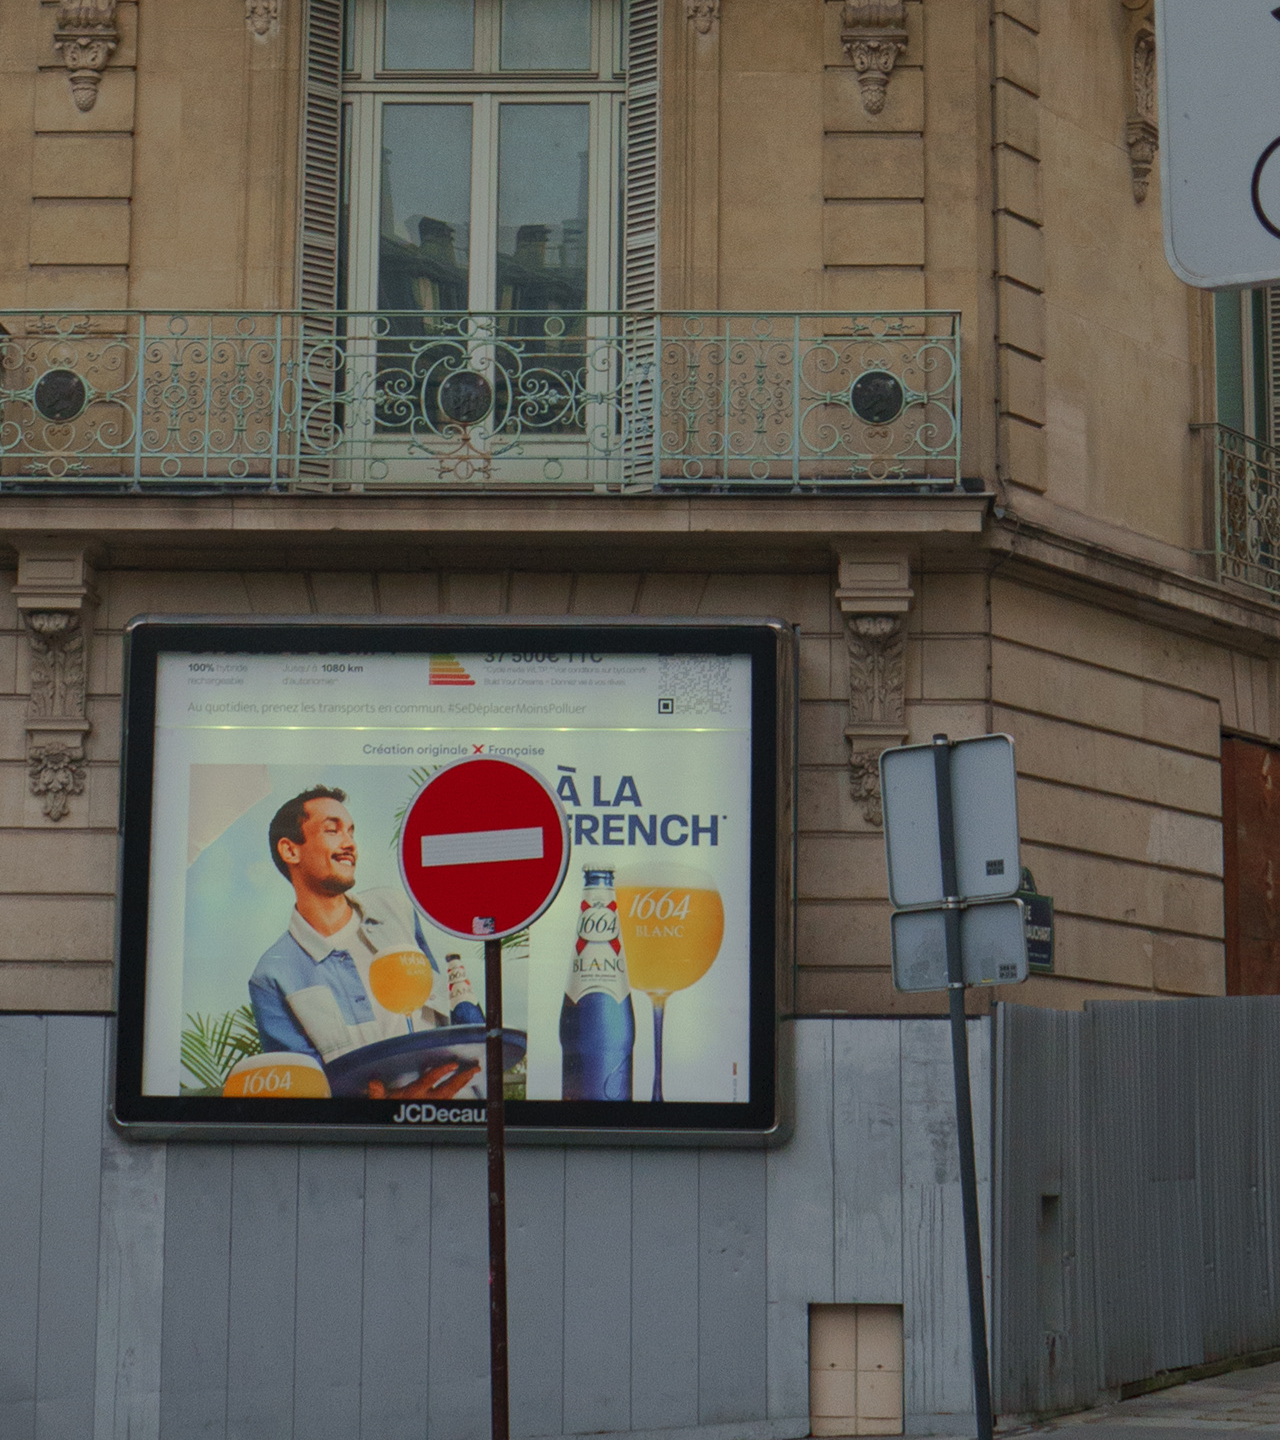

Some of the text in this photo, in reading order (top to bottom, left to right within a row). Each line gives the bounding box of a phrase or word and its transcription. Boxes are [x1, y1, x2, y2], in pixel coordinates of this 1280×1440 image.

[188, 663, 214, 672] 100%
[321, 664, 346, 673] 1080
[347, 664, 364, 673] km
[187, 702, 202, 712] Au
[205, 702, 260, 715] quotidien,
[261, 703, 298, 715] prenez
[301, 701, 316, 712] les
[318, 702, 375, 715] transports
[378, 705, 392, 713] en
[394, 705, 446, 713] commun.
[362, 743, 545, 757] Création originale Française
[556, 764, 643, 807] À LA
[567, 813, 719, 846] RENCH
[629, 888, 692, 921] 1664
[578, 912, 618, 934] 1664
[635, 925, 685, 938] BLANC
[241, 1069, 293, 1096] 1664
[392, 1103, 488, 1123] JCDecau
